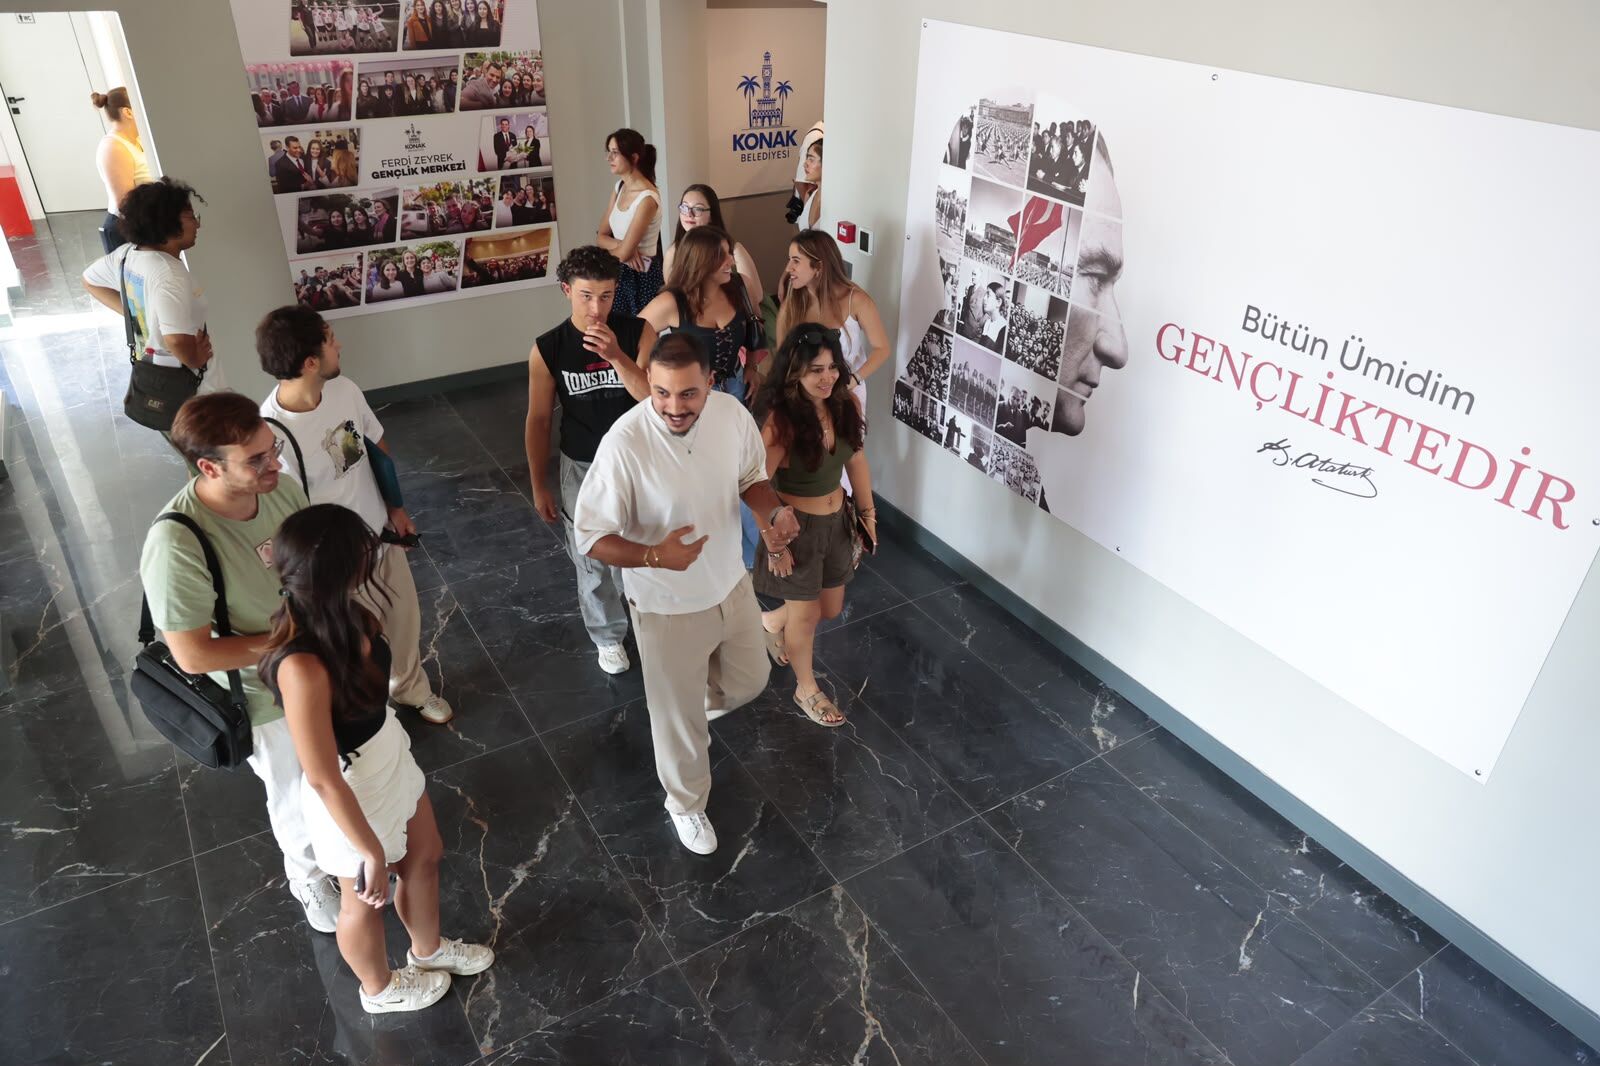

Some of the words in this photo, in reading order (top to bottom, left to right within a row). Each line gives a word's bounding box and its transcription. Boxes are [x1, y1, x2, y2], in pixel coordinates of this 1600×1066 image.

[733, 130, 797, 151] KONAK
[381, 155, 411, 167] FERDİ
[414, 153, 453, 164] ZEYREK
[741, 150, 789, 162] BELEDİYESİ
[371, 165, 418, 179] GENÇLİK
[421, 160, 466, 174] MERKEZİ
[1241, 304, 1329, 360] Bütün
[1338, 335, 1476, 416] Ümidim
[561, 369, 625, 396] LONSDA
[1156, 322, 1576, 530] GENÇLİKTEDİR
